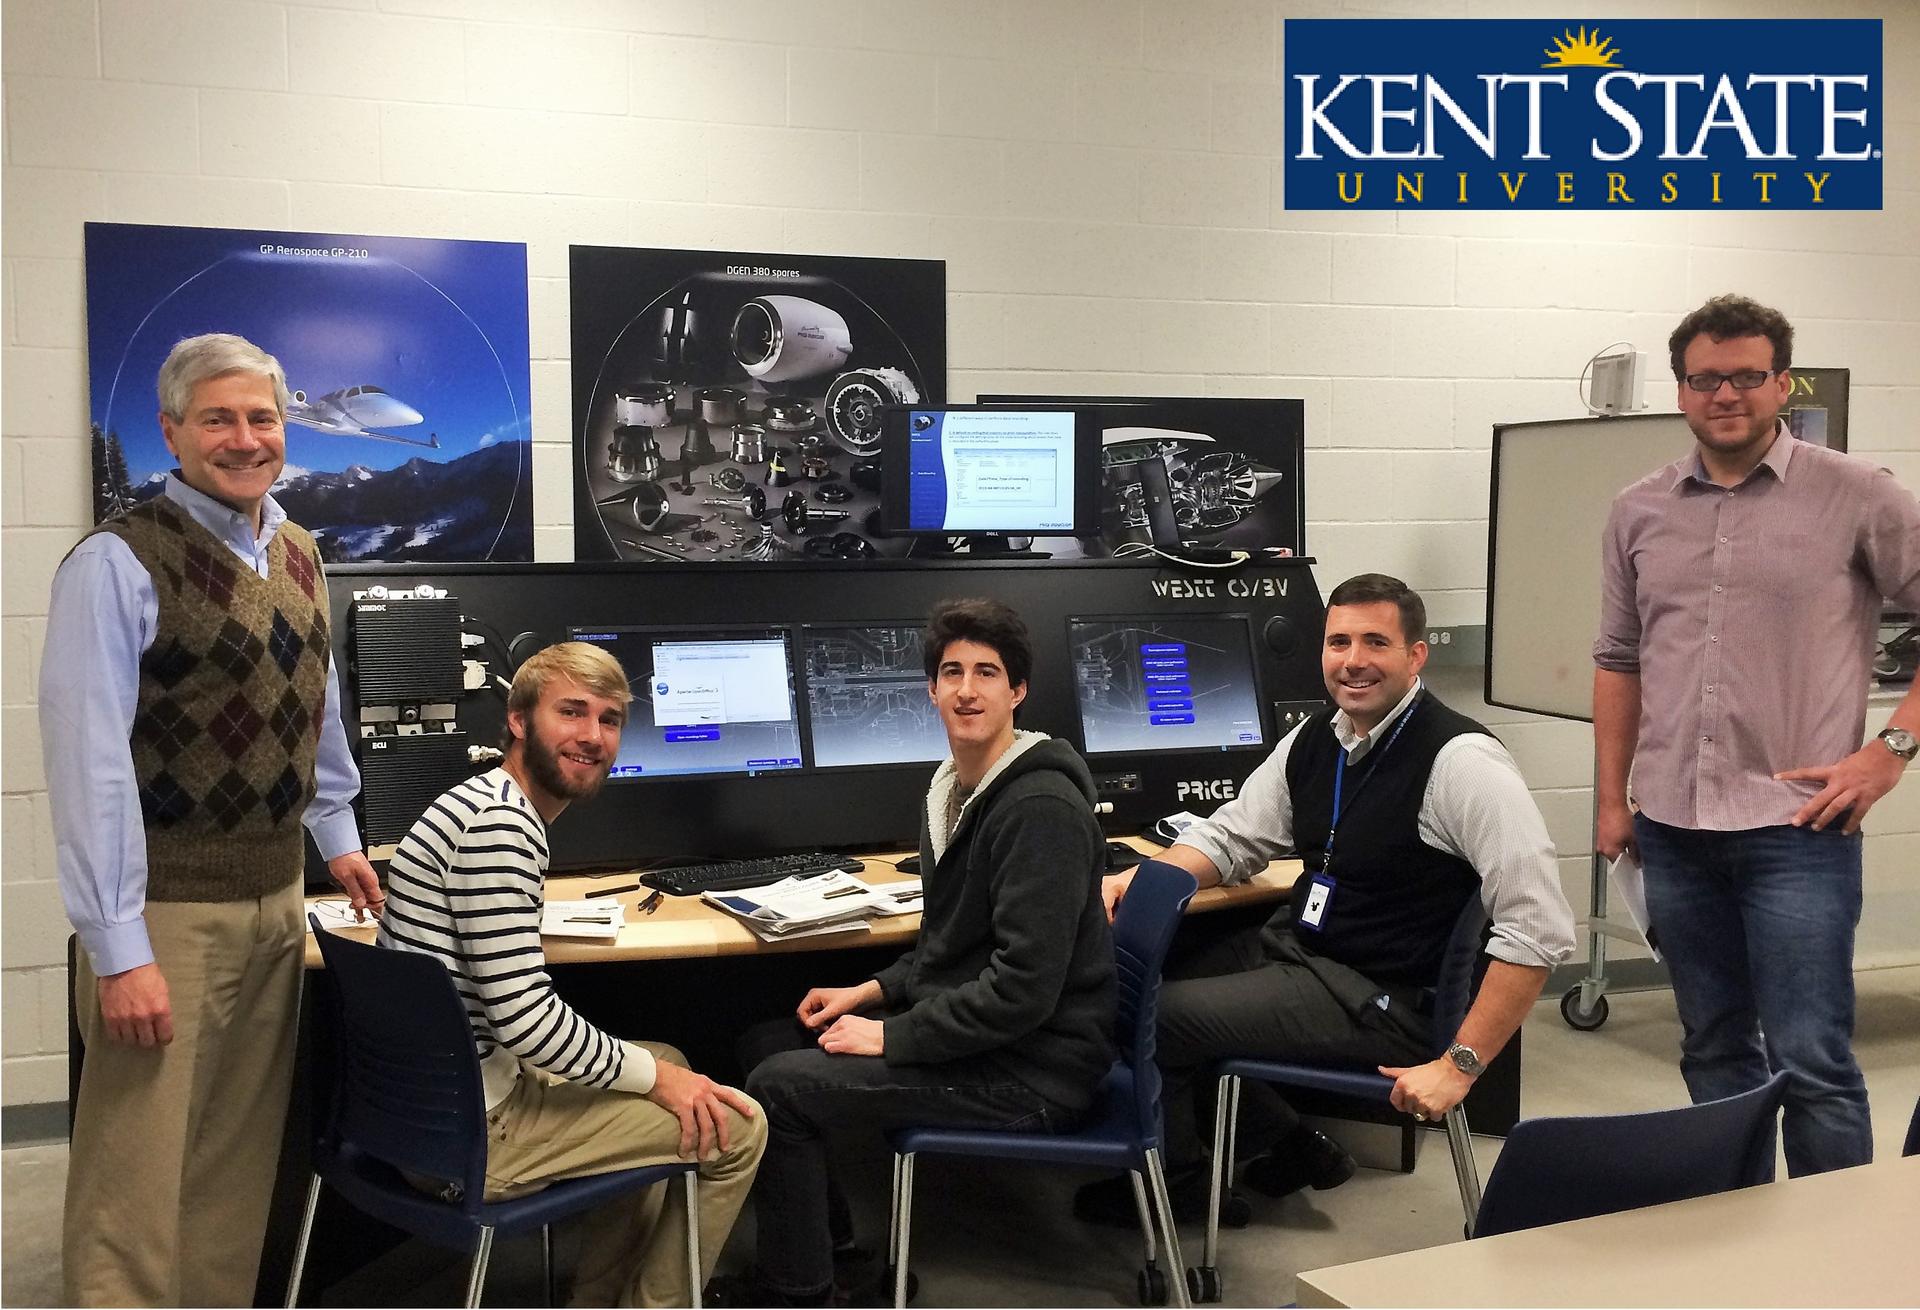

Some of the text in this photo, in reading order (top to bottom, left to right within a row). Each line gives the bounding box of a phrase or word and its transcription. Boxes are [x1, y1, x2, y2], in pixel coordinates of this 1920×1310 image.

[260, 244, 368, 259] GP Aerospace GP-210
[726, 265, 800, 278] DGEN 380 spares
[372, 741, 387, 750] ECU
